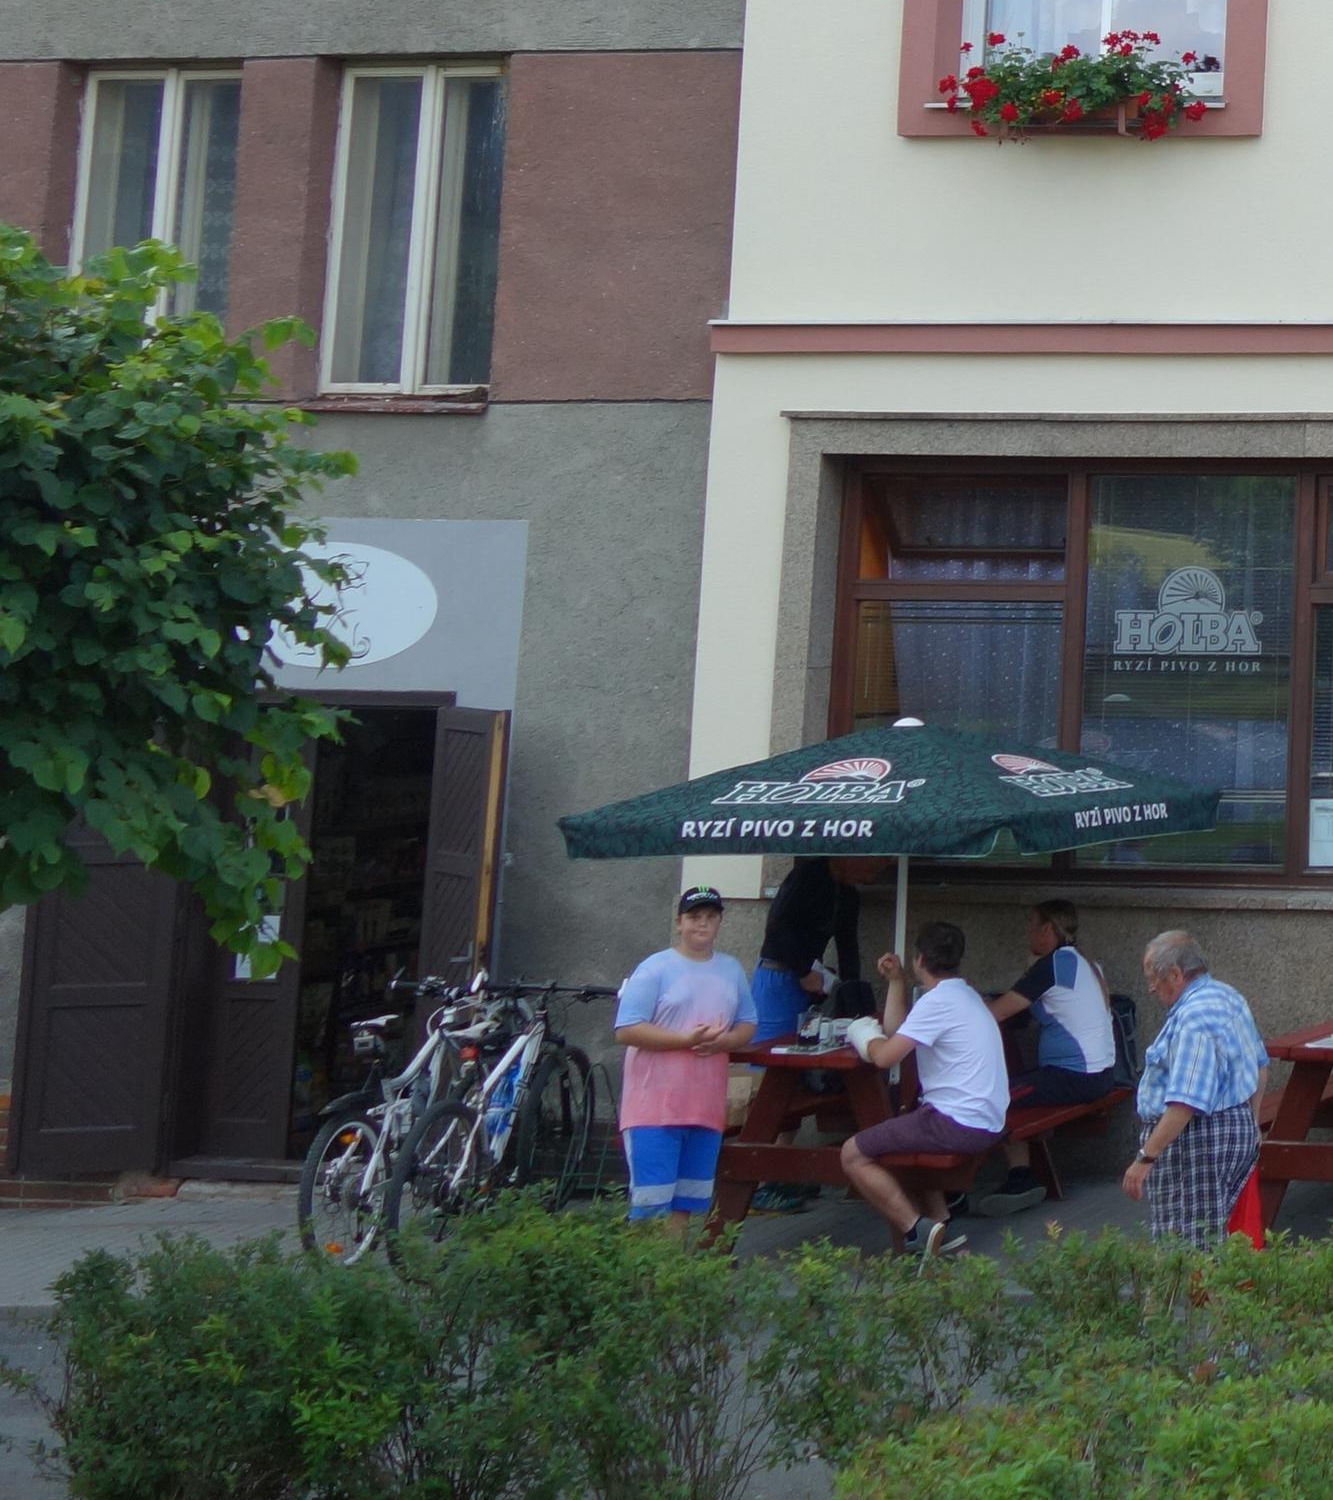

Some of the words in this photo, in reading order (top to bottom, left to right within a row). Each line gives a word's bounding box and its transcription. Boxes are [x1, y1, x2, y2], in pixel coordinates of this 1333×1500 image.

[1114, 610, 1262, 655] HOLBA
[1113, 657, 1153, 671] RYZÍ
[1161, 660, 1200, 672] PIVO
[1207, 660, 1217, 672] Z
[1225, 660, 1262, 673] HOR
[710, 780, 907, 805] HOLBA
[681, 817, 738, 838] RYZÍ
[740, 819, 794, 838] PIVO
[801, 820, 816, 838] Z
[823, 820, 873, 838] HOR
[1074, 806, 1102, 829] RYZÍ
[1104, 806, 1132, 826] PIVO
[1133, 805, 1143, 822] Z
[1143, 803, 1168, 821] HOR
